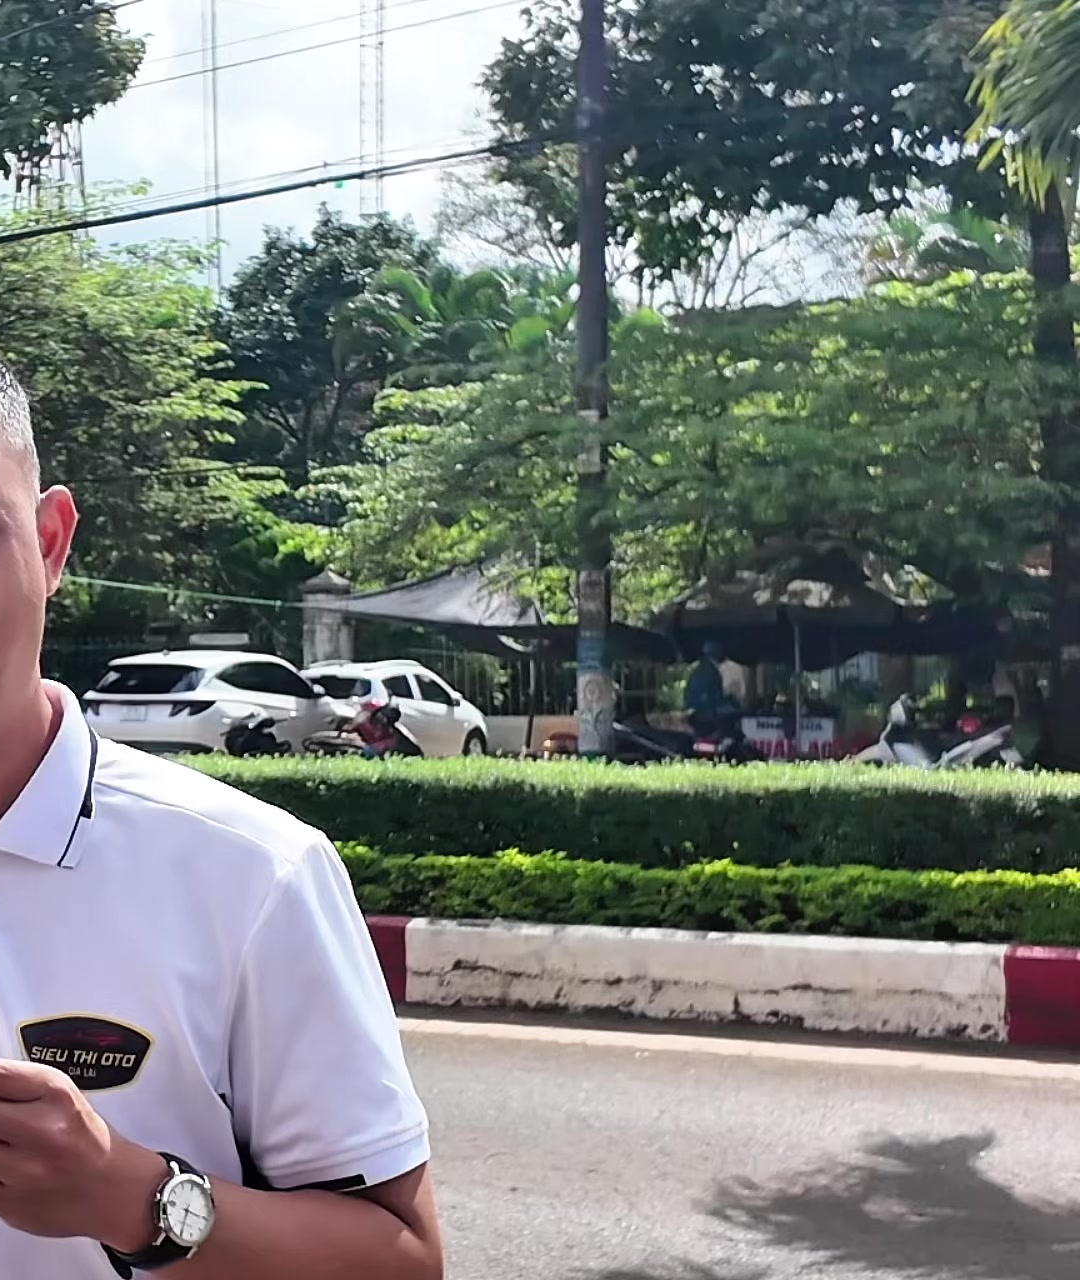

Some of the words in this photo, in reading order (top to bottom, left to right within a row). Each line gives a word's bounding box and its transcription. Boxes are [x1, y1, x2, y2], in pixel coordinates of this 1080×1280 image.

[30, 1046, 68, 1061] SIEU
[73, 1049, 98, 1065] THI
[101, 1053, 136, 1067] OTO
